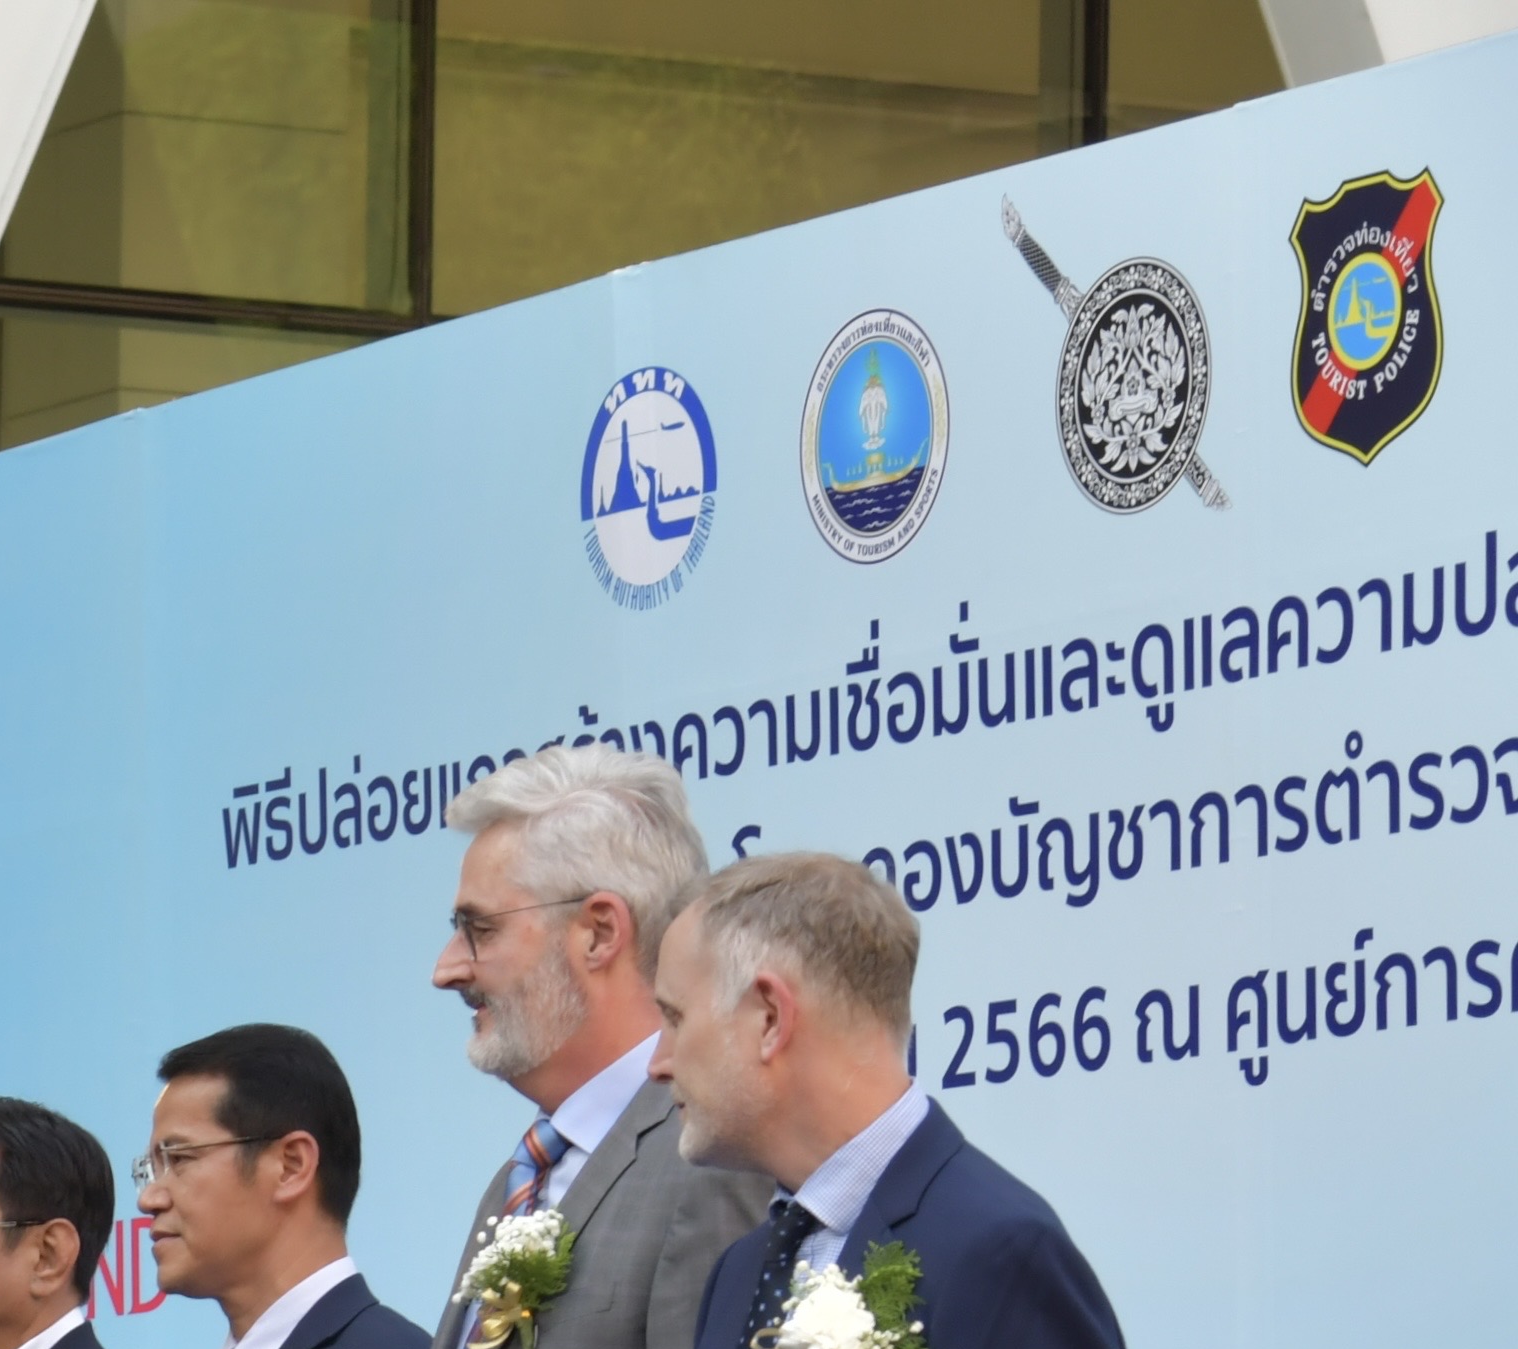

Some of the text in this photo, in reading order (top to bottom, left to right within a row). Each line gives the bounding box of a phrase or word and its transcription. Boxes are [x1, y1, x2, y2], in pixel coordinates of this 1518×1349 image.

[1311, 308, 1420, 400] TOURIST POLICE
[584, 495, 716, 611] TOURISM AUTHORITY OF THAILAND
[811, 467, 939, 556] MINISTRY OF TOURISM AND SPORTS
[941, 985, 1112, 1090] 2566
[1134, 984, 1201, 1064] ณ
[1226, 927, 1518, 1086] ศูนย์การ
